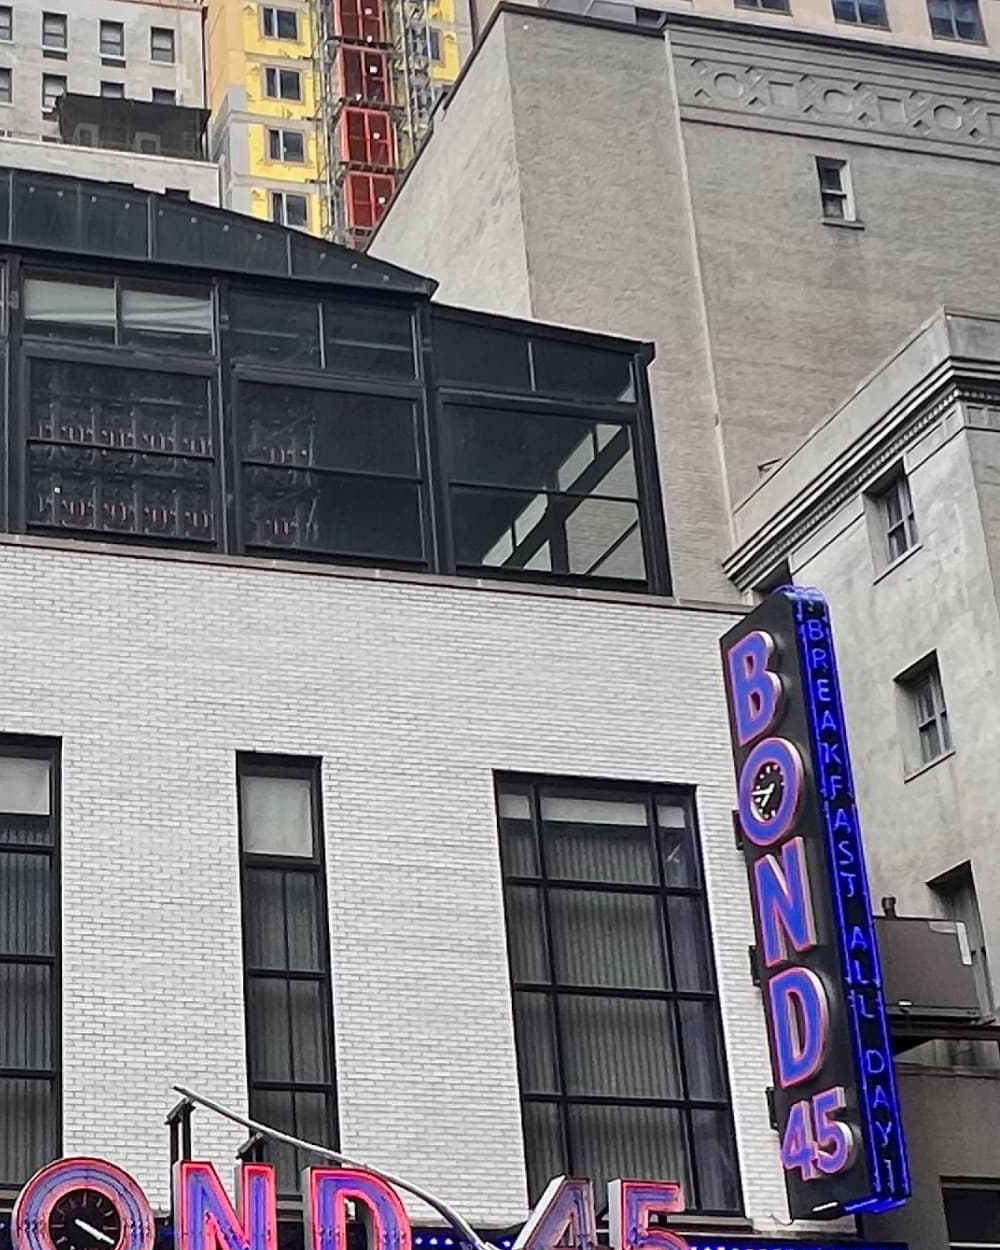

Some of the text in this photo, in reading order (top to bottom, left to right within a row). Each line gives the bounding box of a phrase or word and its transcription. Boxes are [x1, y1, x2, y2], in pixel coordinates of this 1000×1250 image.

[727, 630, 830, 1089] BOND
[805, 618, 858, 898] BREAKFAST
[849, 925, 876, 1019] ALL
[781, 1085, 854, 1182] 45
